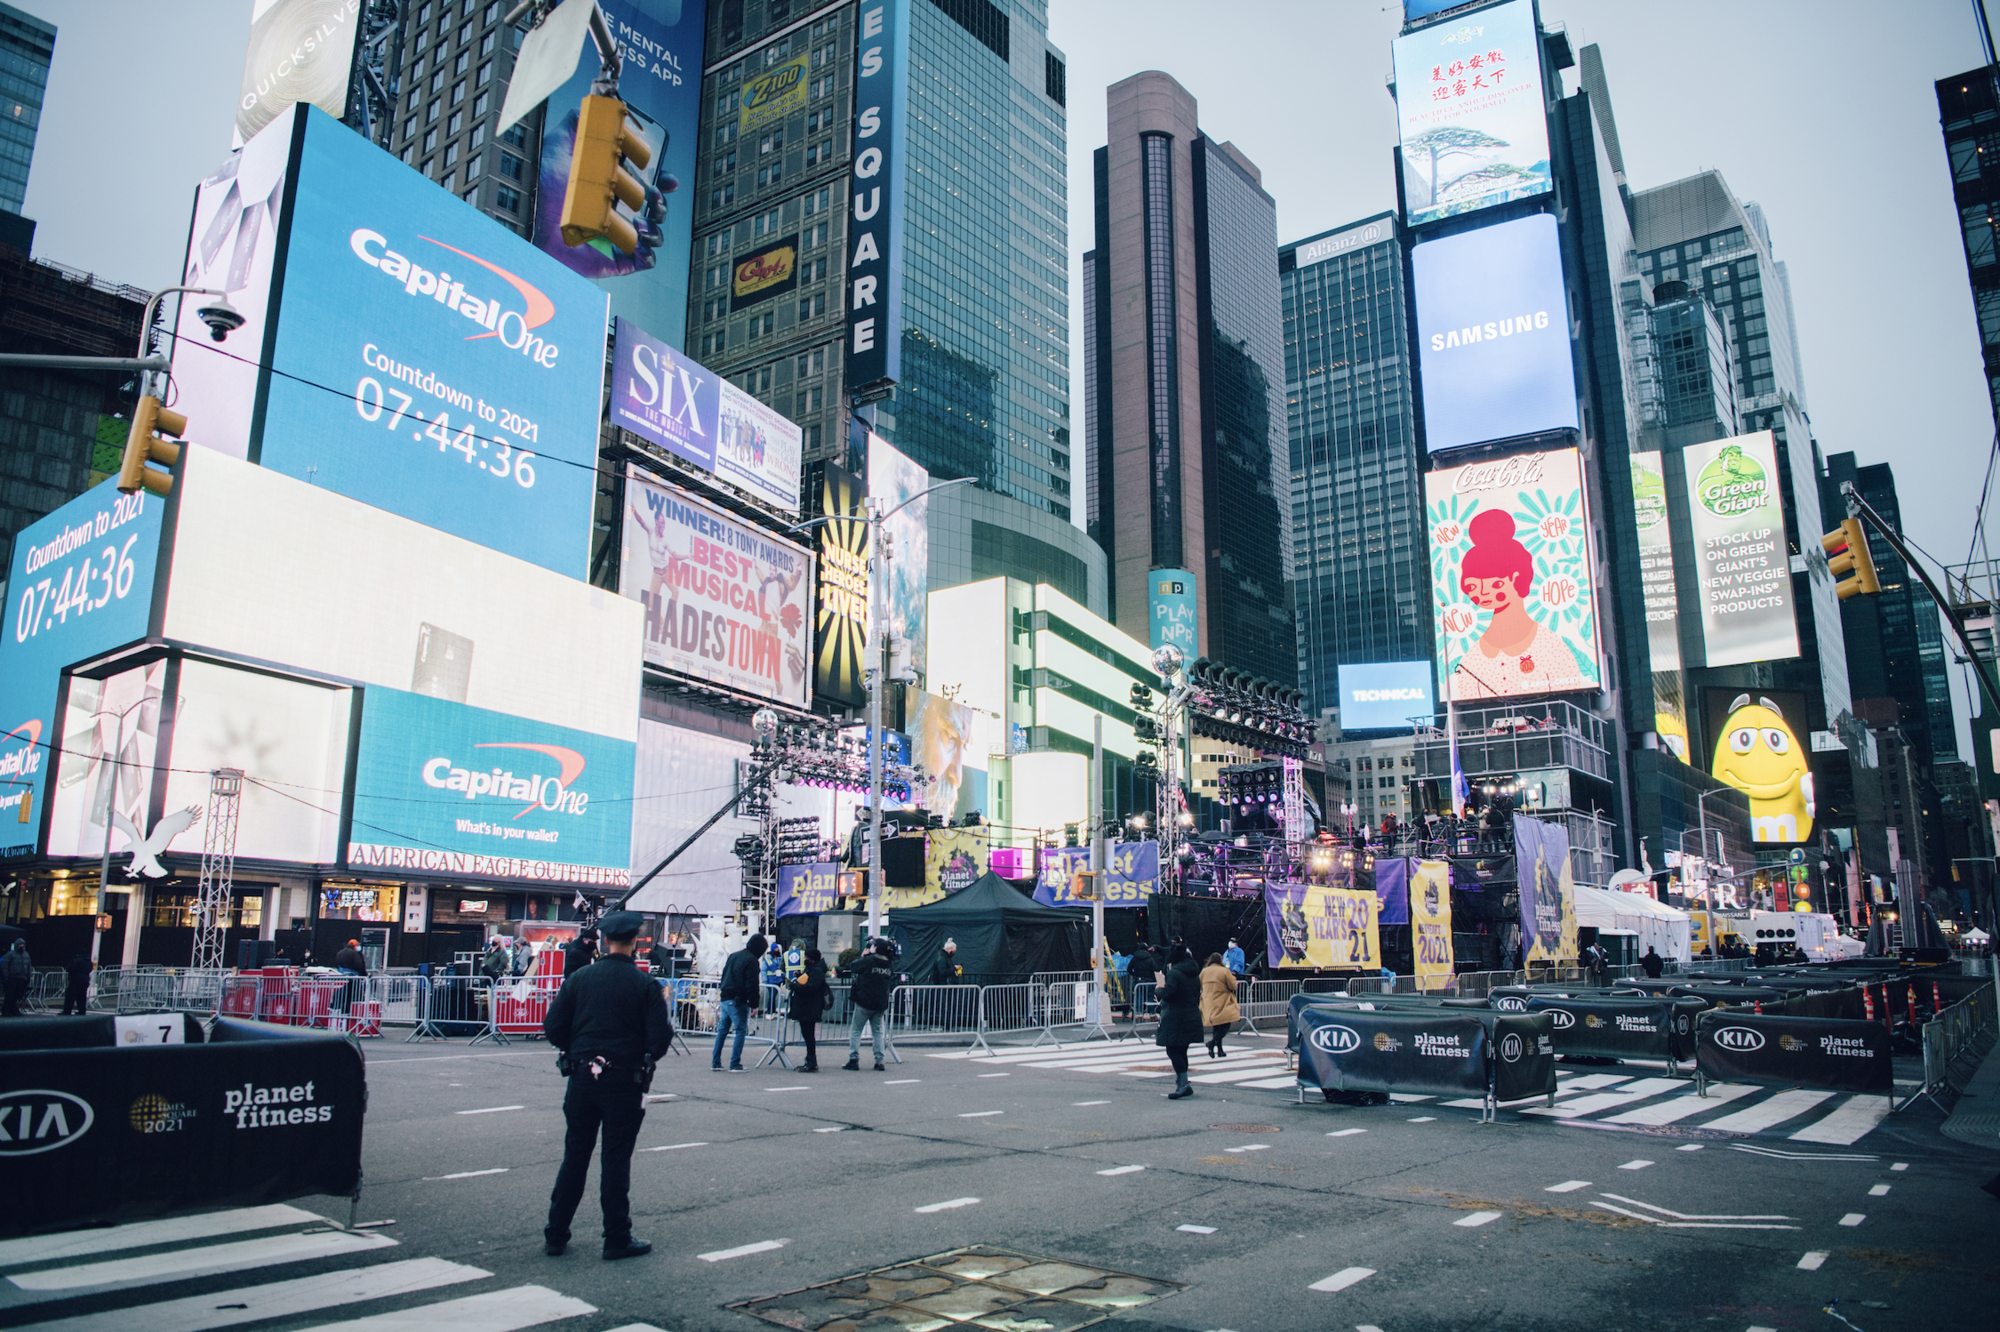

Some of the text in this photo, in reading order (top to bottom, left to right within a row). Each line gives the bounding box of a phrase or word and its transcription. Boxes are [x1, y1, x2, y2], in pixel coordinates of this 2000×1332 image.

[619, 21, 682, 71] MENTAL
[650, 63, 682, 87] APP
[1431, 49, 1507, 83] 美好安徽
[749, 64, 801, 110] Z100
[1432, 69, 1507, 101] 迎客天下
[1409, 106, 1454, 123] BEAUTIFUL
[1487, 83, 1532, 100] DISCOVER
[1443, 111, 1461, 120] FOR
[1464, 97, 1509, 114] YOURSELF
[851, 106, 884, 354] SQUARE
[1306, 234, 1359, 261] Allianz
[1431, 311, 1549, 351] SAMSUNG
[362, 343, 539, 443] Countdown to 2021
[355, 376, 536, 488] 07:44:36
[645, 406, 659, 423] THE
[660, 415, 691, 440] MUSICAL
[766, 452, 798, 483] WRONG
[1452, 454, 1546, 495] Coca-Cola
[1704, 479, 1765, 501] Green
[1713, 492, 1769, 515] Giant
[26, 489, 146, 576] Countdown to 2021
[645, 488, 795, 574] WINNER! 8 TONY AWARDS
[1706, 528, 1772, 549] STOCK UP
[692, 536, 753, 583] BEST
[825, 540, 867, 578] NURSE
[1706, 541, 1775, 562] ON GREEN
[1715, 556, 1769, 574] GIANT'S
[16, 532, 138, 643] 07:44:36
[667, 556, 772, 622] MUSICAL
[824, 564, 866, 598] HEROES
[1161, 583, 1189, 593] npr
[1702, 567, 1786, 590] NEW VEGGIE
[823, 582, 866, 627] LIVE!
[1710, 595, 1784, 616] PRODUCTS
[640, 588, 782, 682] HADESTOWN
[1352, 687, 1425, 702] TECHNICAL
[456, 818, 560, 843] What's in your wallet?
[351, 843, 631, 887] AMERICAN EAGLE OUTFITTERS
[941, 872, 970, 882] planet
[791, 869, 837, 898] plan
[1716, 883, 1748, 910] R
[1324, 896, 1369, 930] NEW 20
[1535, 901, 1557, 920] planet
[1282, 928, 1303, 941] planet
[1312, 916, 1348, 940] YEAR'S
[1538, 916, 1562, 933] fitness
[1330, 929, 1371, 963] EVE 21
[1418, 935, 1450, 964] 2021
[1502, 1001, 1525, 1012] KIA
[1553, 1013, 1569, 1025] IA
[1615, 1014, 1650, 1025] planet
[1620, 1021, 1657, 1032] fitness
[159, 1025, 172, 1043] 7
[1319, 1031, 1351, 1048] KIA
[1414, 1032, 1460, 1047] planet
[1722, 1031, 1758, 1047] KIA
[1820, 1035, 1865, 1047] planet
[1380, 1044, 1397, 1052] 2021
[1420, 1043, 1470, 1058] fitness
[1504, 1039, 1519, 1056] KIA
[1826, 1046, 1874, 1057] fitness
[157, 1103, 185, 1112] TIMES
[224, 1081, 315, 1114] planet
[144, 1118, 183, 1133] 2021
[161, 1109, 198, 1120] SQUARE
[236, 1105, 332, 1129] fitness
